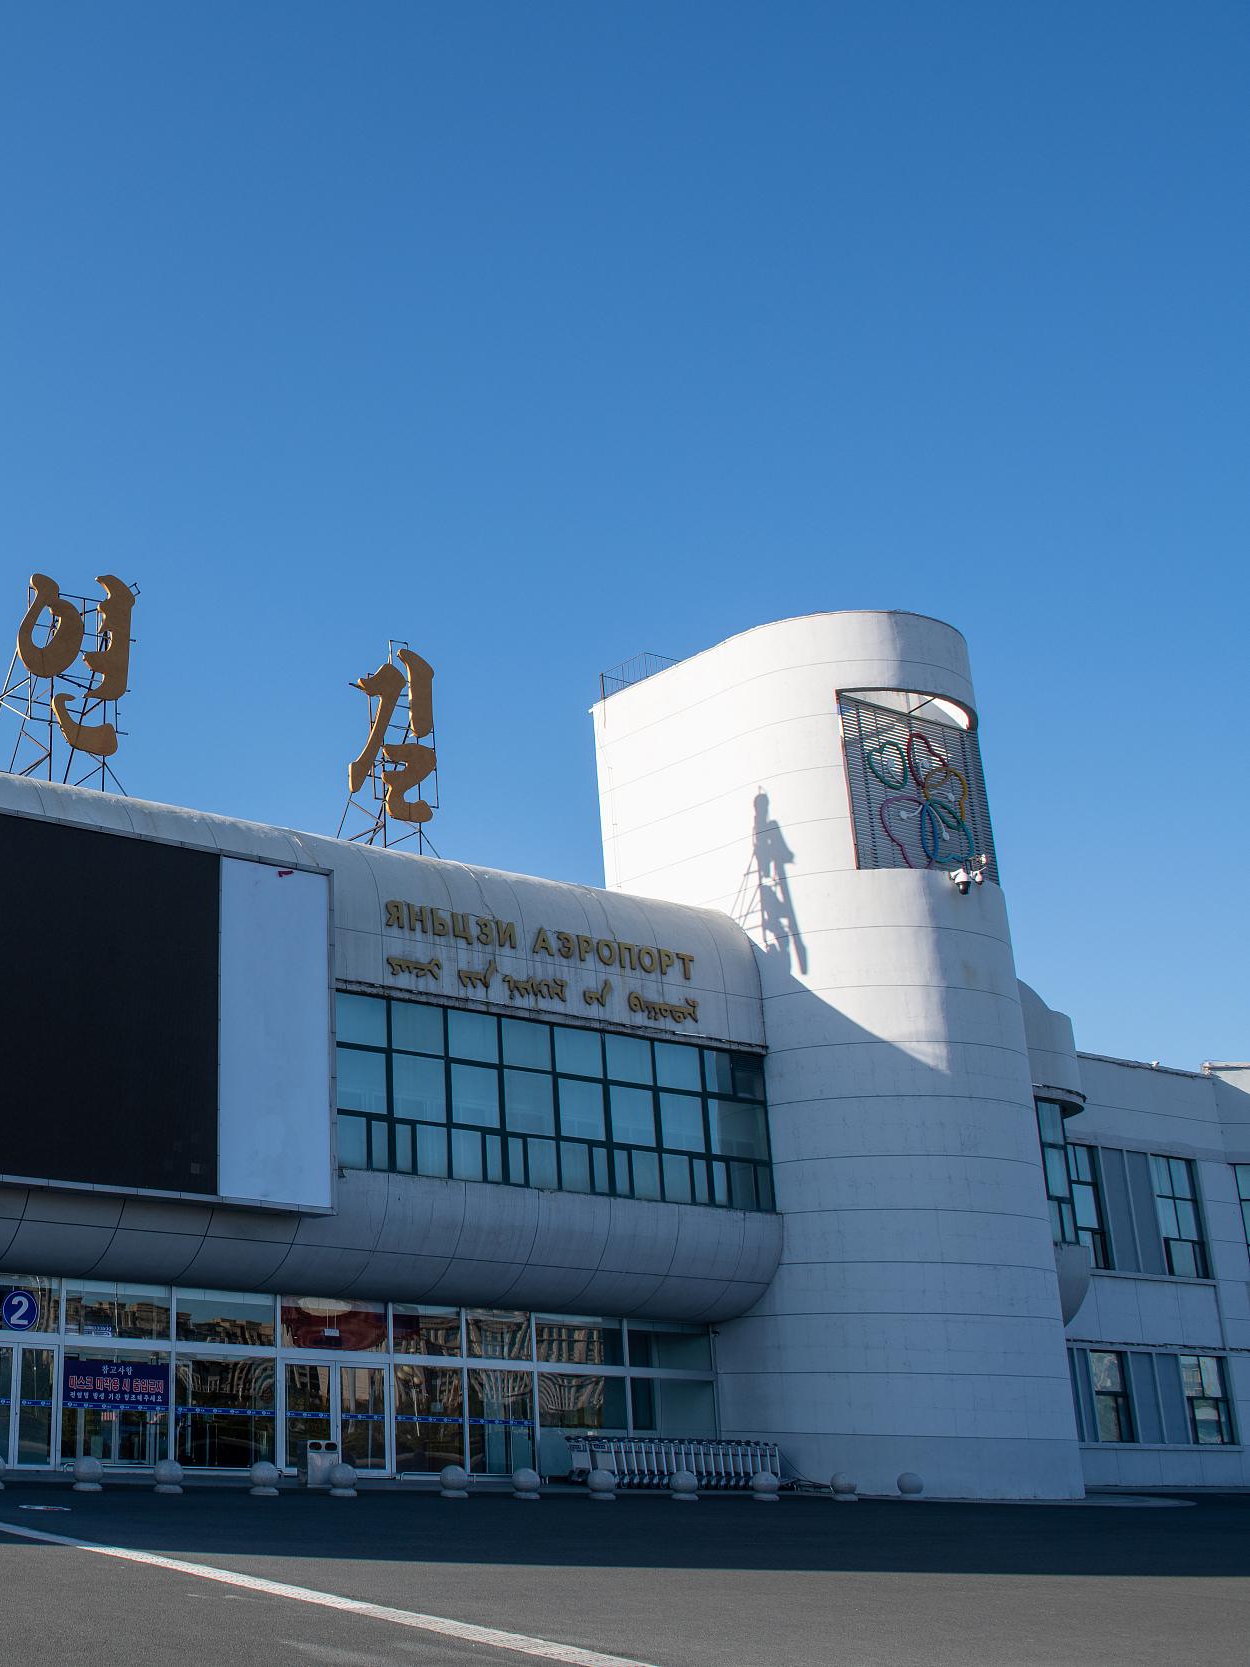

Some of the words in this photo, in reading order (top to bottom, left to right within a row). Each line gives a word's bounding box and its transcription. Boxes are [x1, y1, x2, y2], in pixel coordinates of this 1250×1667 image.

[385, 899, 517, 949] ЯНЬЦЗИ
[532, 926, 695, 981] АЭРОПОРТ
[10, 1296, 29, 1326] 2
[101, 1364, 134, 1376] 참고사항
[68, 1375, 94, 1390] 마스크
[96, 1376, 120, 1392] 미착용
[121, 1377, 130, 1392] 시
[132, 1378, 164, 1394] 출입금지
